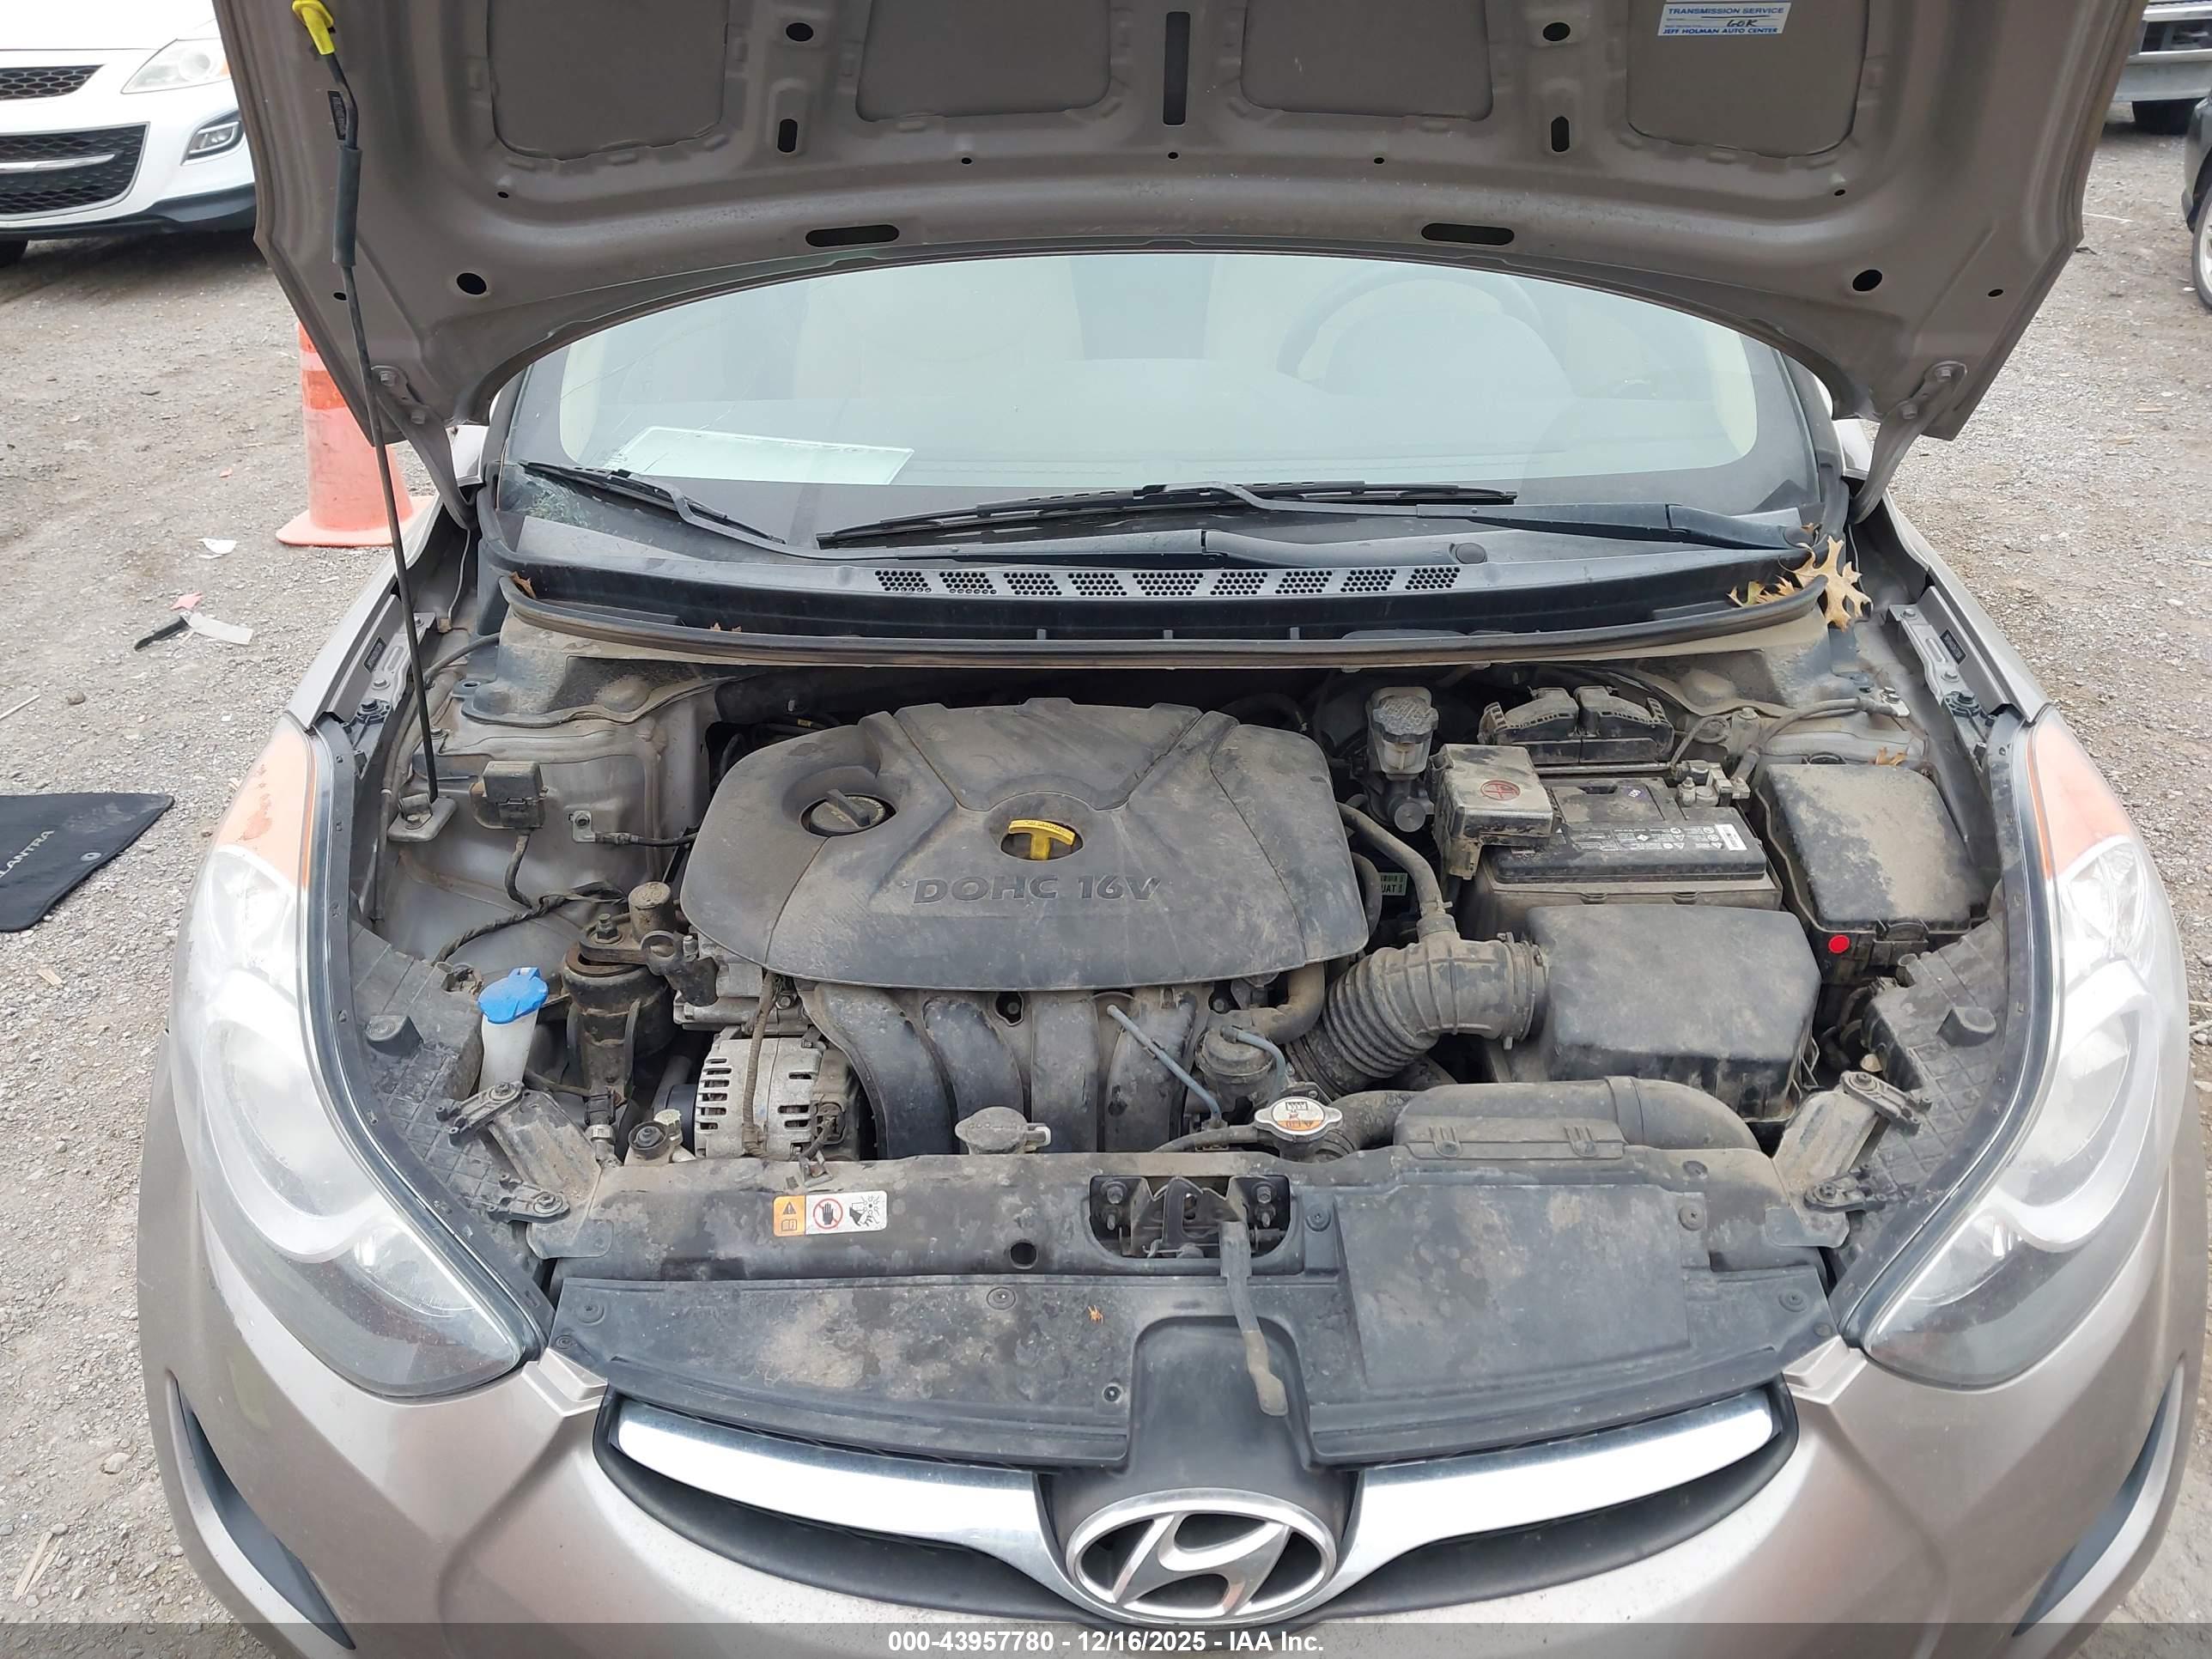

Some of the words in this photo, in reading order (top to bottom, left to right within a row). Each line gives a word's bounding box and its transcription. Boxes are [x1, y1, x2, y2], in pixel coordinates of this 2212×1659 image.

[0, 830, 55, 878] LANTRA
[914, 875, 1058, 903] DOHC
[1078, 875, 1162, 901] 16V
